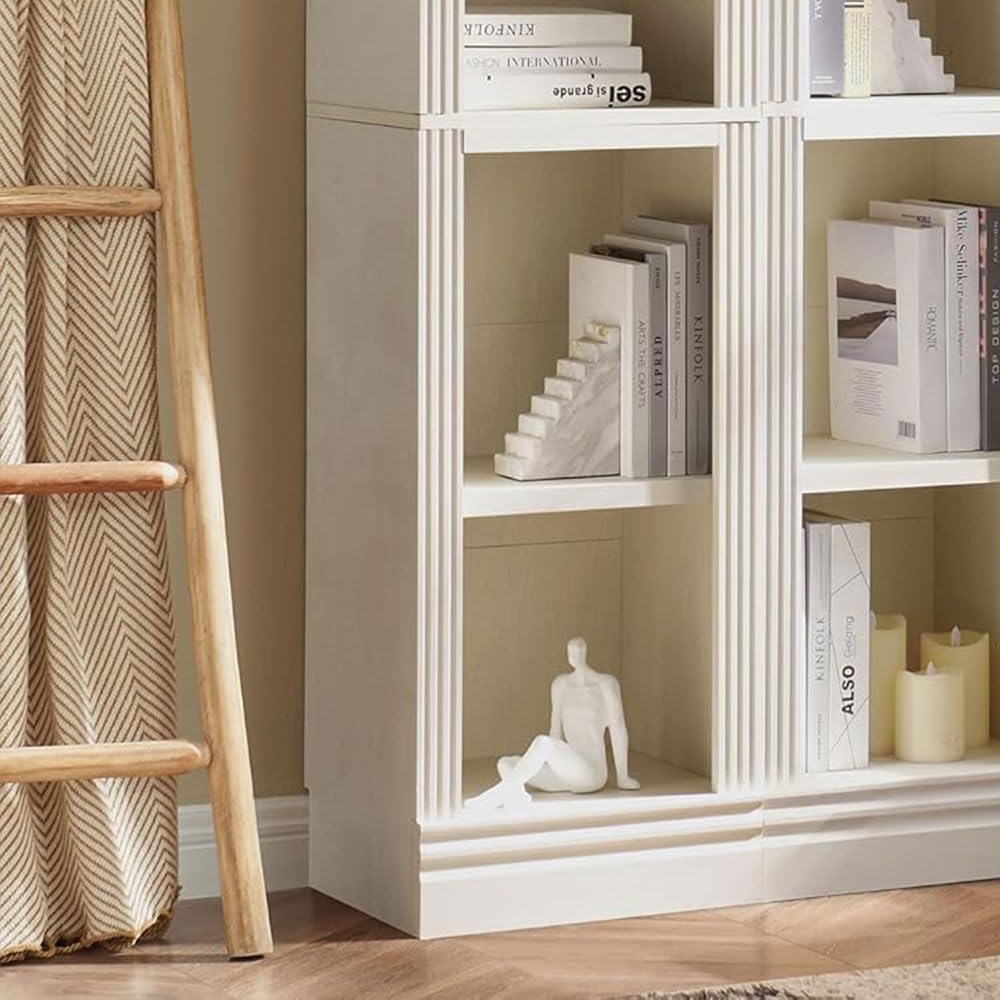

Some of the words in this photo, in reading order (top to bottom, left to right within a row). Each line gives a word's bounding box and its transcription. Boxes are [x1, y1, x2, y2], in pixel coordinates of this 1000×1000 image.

[464, 23, 535, 36] KINFOLK
[506, 56, 602, 68] INTERNATIONAL
[552, 84, 595, 99] grande
[596, 85, 607, 98] si
[608, 84, 647, 108] sei
[955, 209, 968, 240] Mike
[991, 288, 1000, 347] DESIGN
[638, 320, 646, 345] ARTS
[638, 349, 646, 369] THE
[692, 315, 704, 384] KINFOLK
[991, 354, 1000, 385] TOP
[638, 372, 646, 409] CRAFTS
[815, 615, 825, 681] KINFOLK
[841, 665, 856, 715] ALSO
